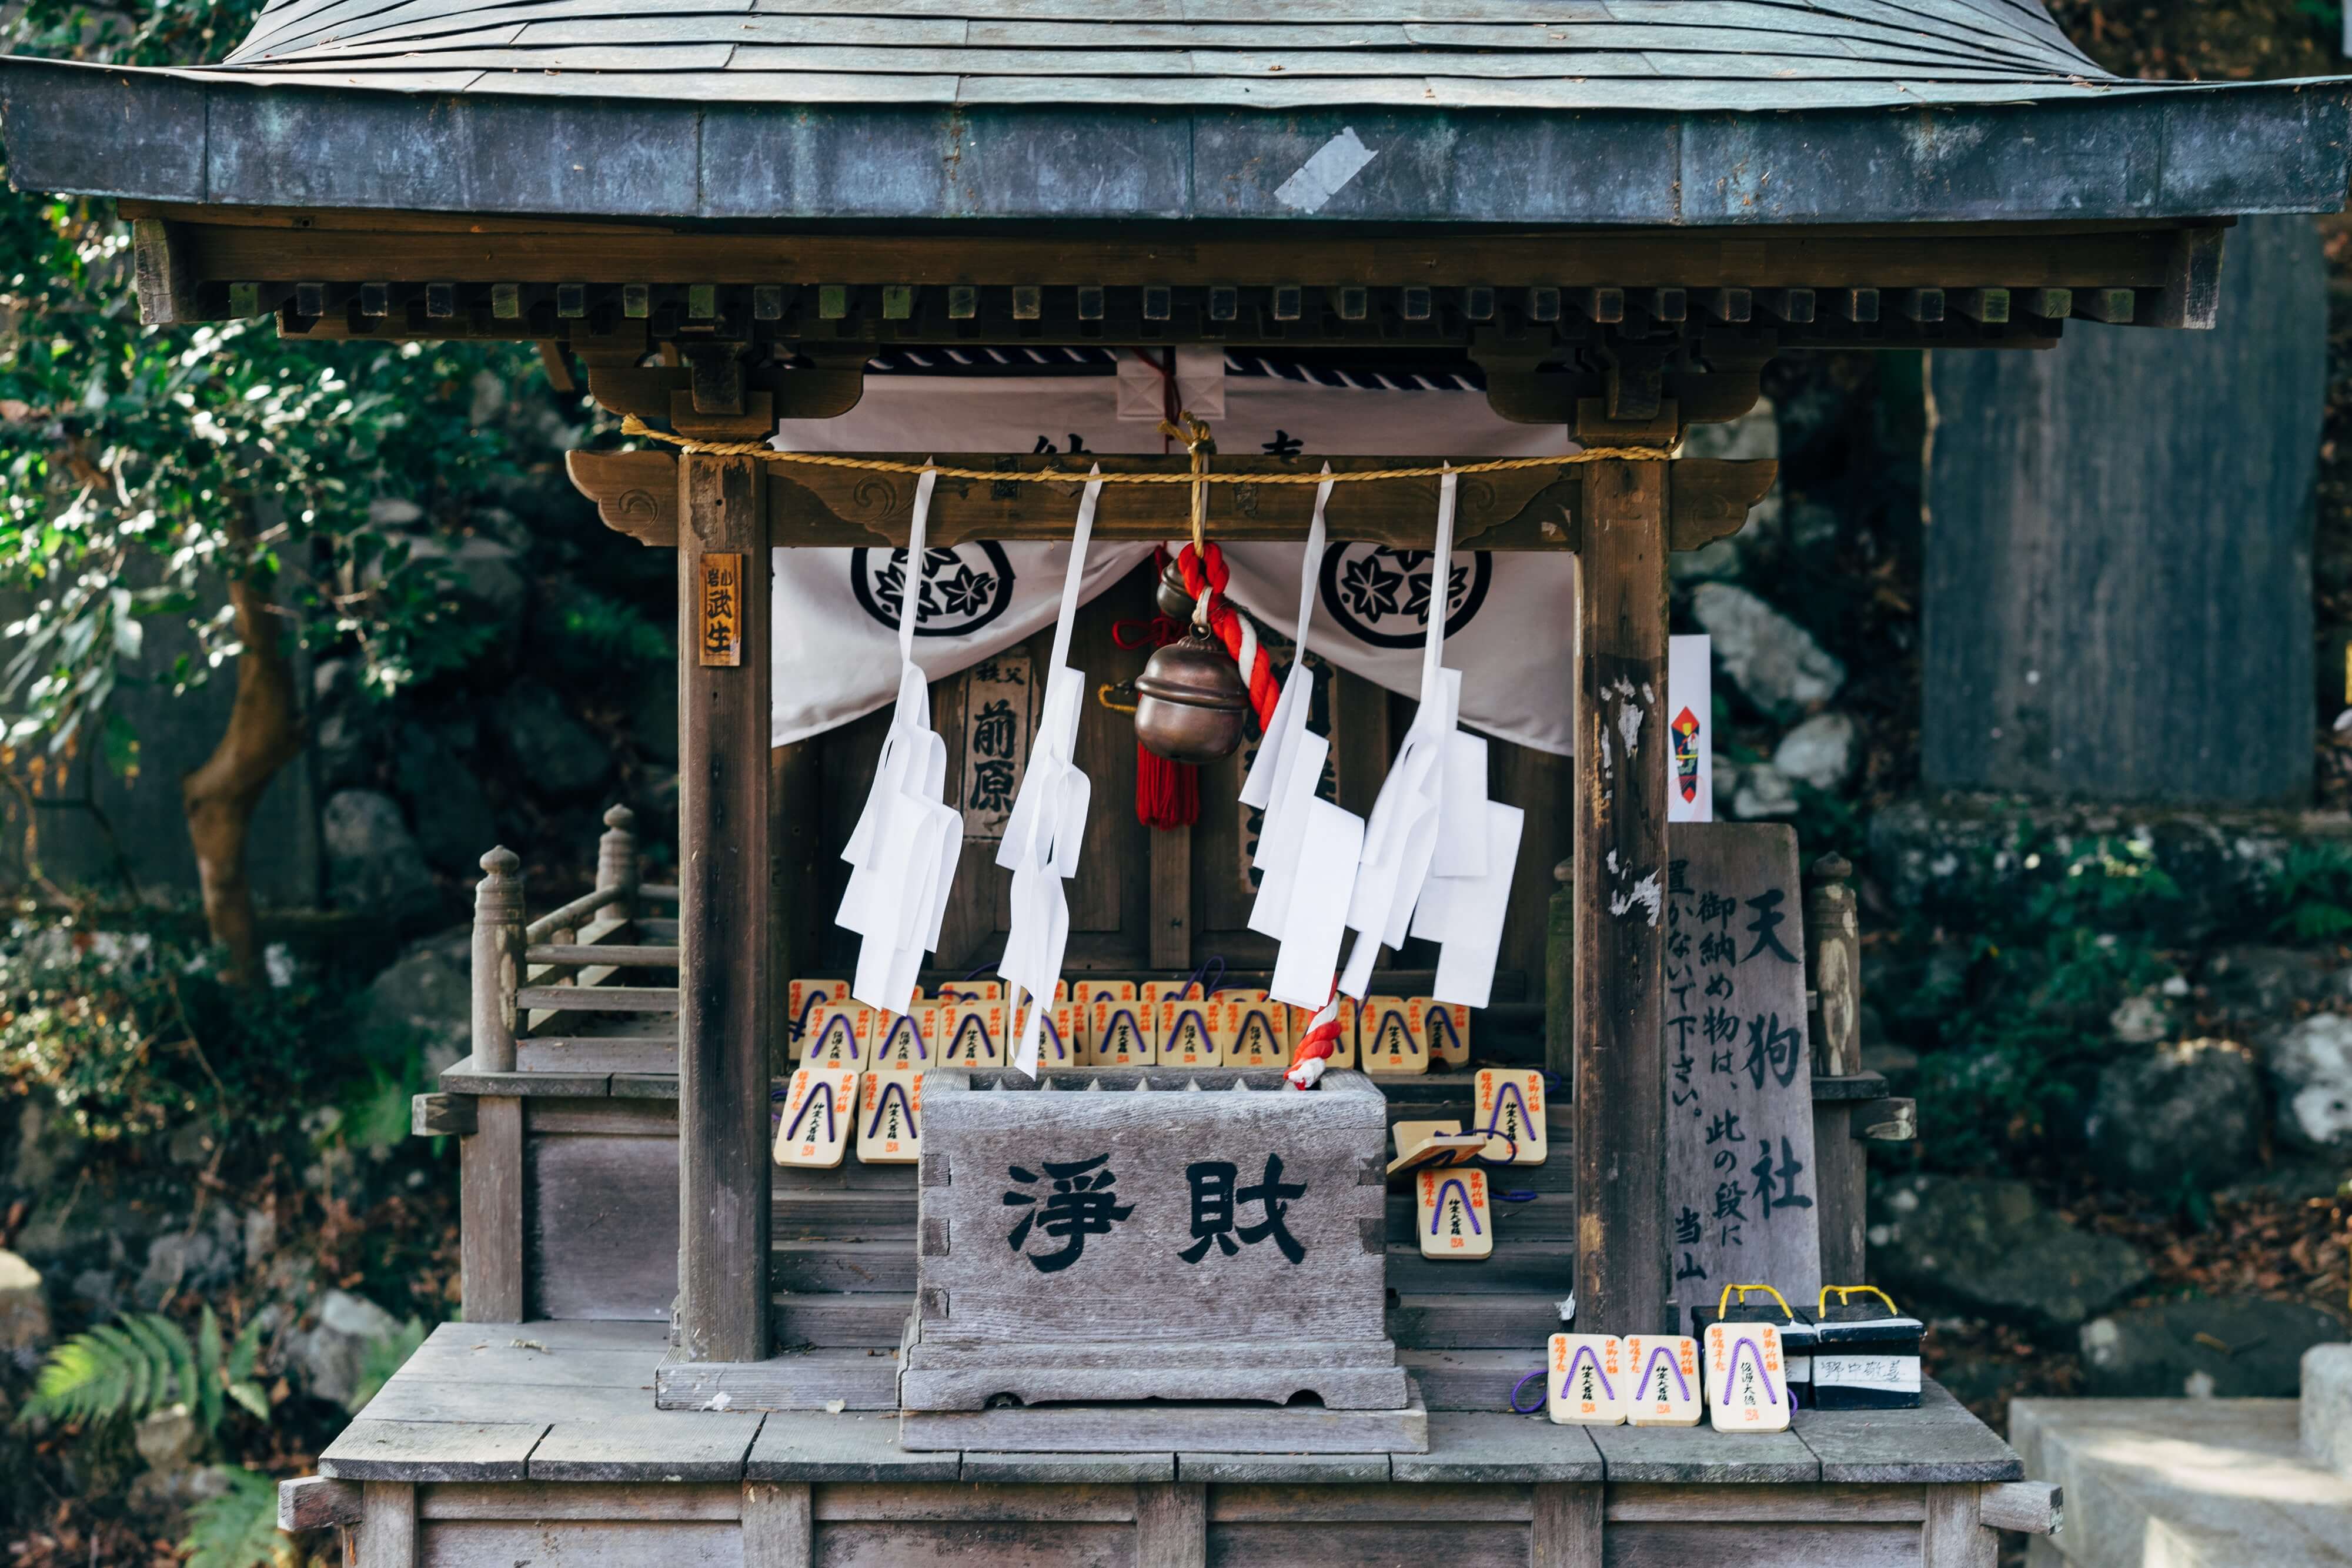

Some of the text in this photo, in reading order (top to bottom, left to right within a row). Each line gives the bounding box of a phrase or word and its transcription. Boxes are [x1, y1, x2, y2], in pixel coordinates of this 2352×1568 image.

[976, 664, 1025, 686] 秩父
[970, 698, 1016, 813] 前原
[1739, 888, 1813, 1219] 天狗社
[1003, 1153, 1307, 1273] 淨財
[1674, 1206, 1707, 1281] 当山
